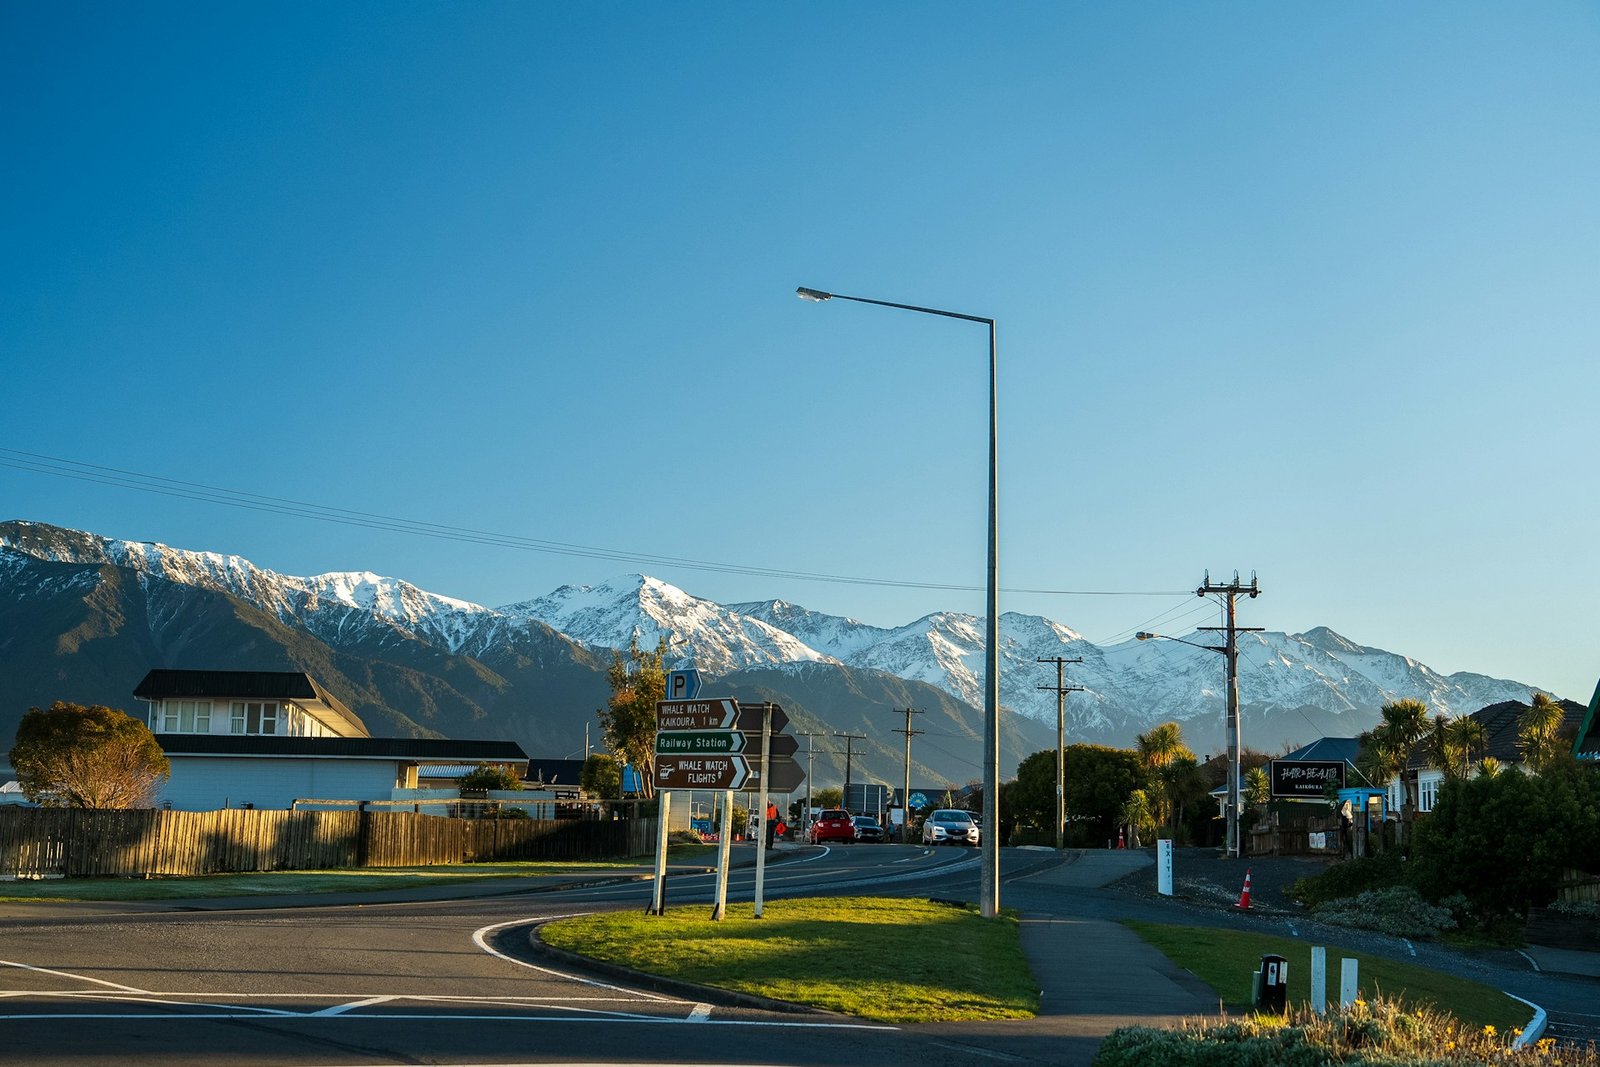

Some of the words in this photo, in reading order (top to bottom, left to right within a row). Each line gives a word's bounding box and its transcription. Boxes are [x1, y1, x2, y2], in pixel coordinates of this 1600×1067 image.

[674, 675, 685, 697] P
[661, 705, 684, 714] WHALE
[687, 704, 710, 714] WATCH
[660, 717, 695, 727] KAIKOURA
[709, 717, 719, 725] km
[660, 738, 692, 749] Railway
[696, 738, 727, 747] Station
[678, 761, 702, 770] WHALE
[705, 761, 728, 770] WATCH
[688, 773, 716, 783] FLIGHTS
